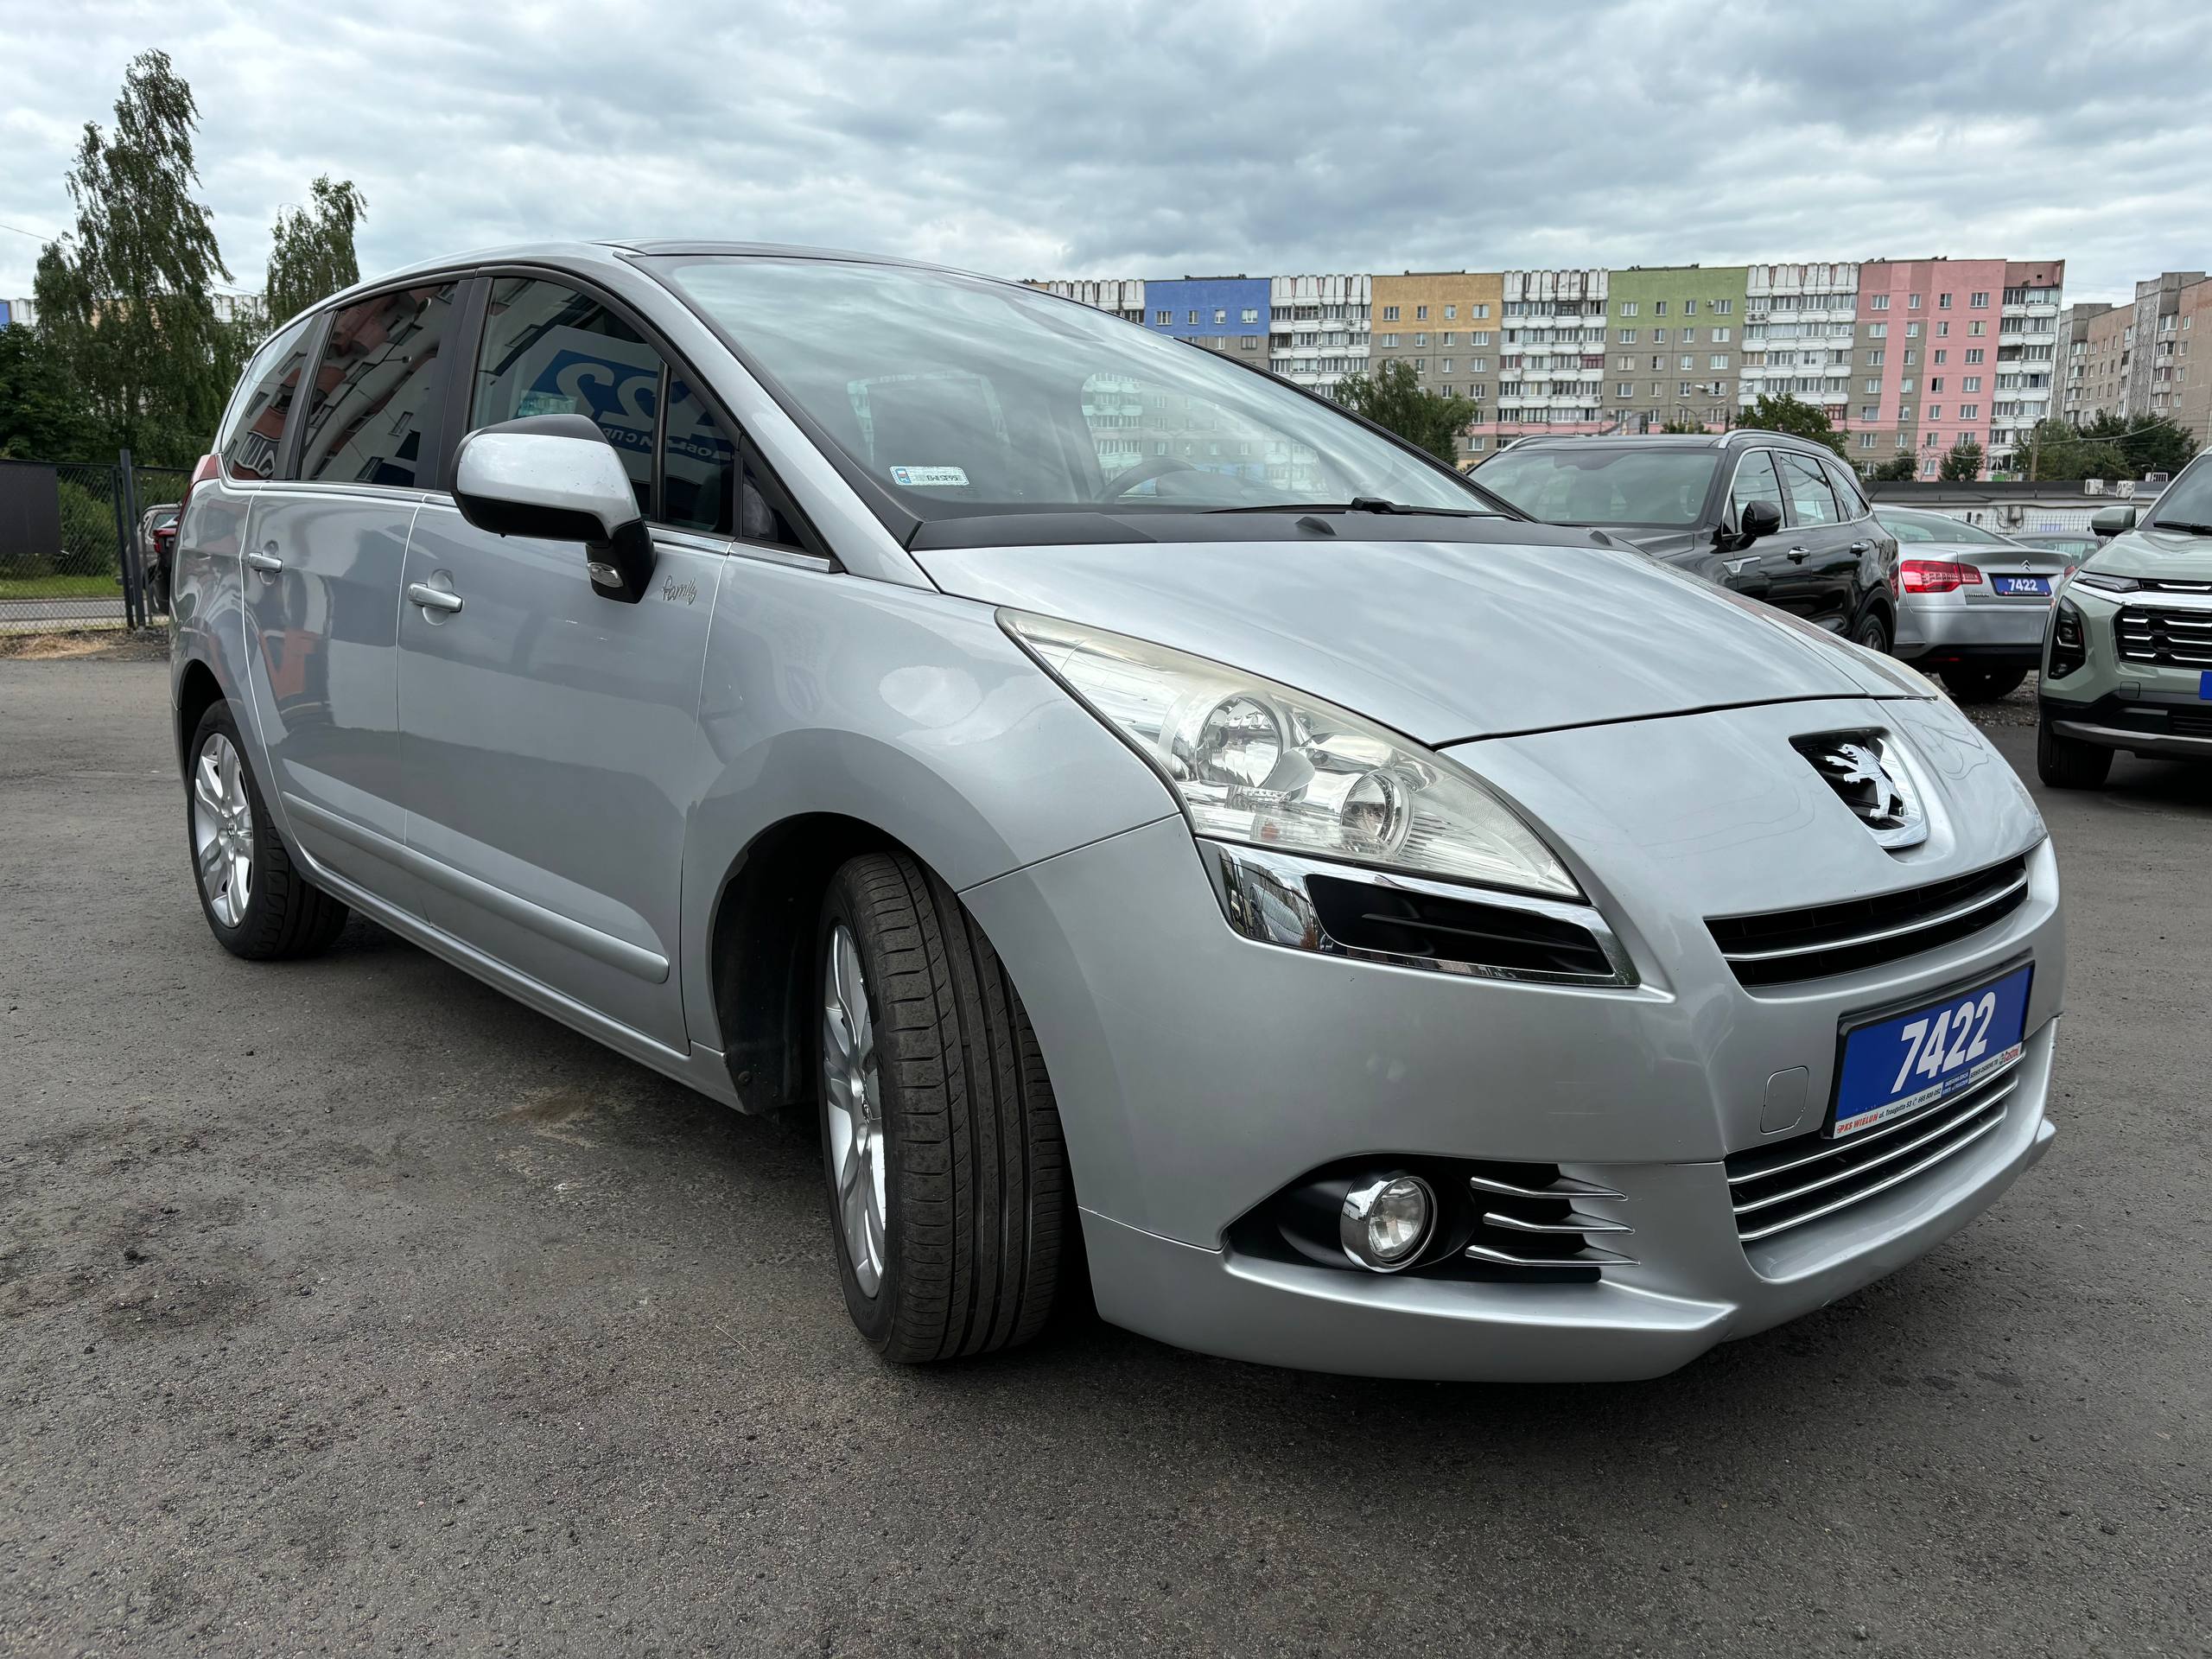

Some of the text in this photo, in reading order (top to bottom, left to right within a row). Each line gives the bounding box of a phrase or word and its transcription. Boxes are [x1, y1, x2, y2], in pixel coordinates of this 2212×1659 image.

[661, 575, 697, 606] family
[2007, 579, 2038, 591] 7422
[1891, 991, 1996, 1095] 7422
[1839, 1122, 1853, 1134] PKS
